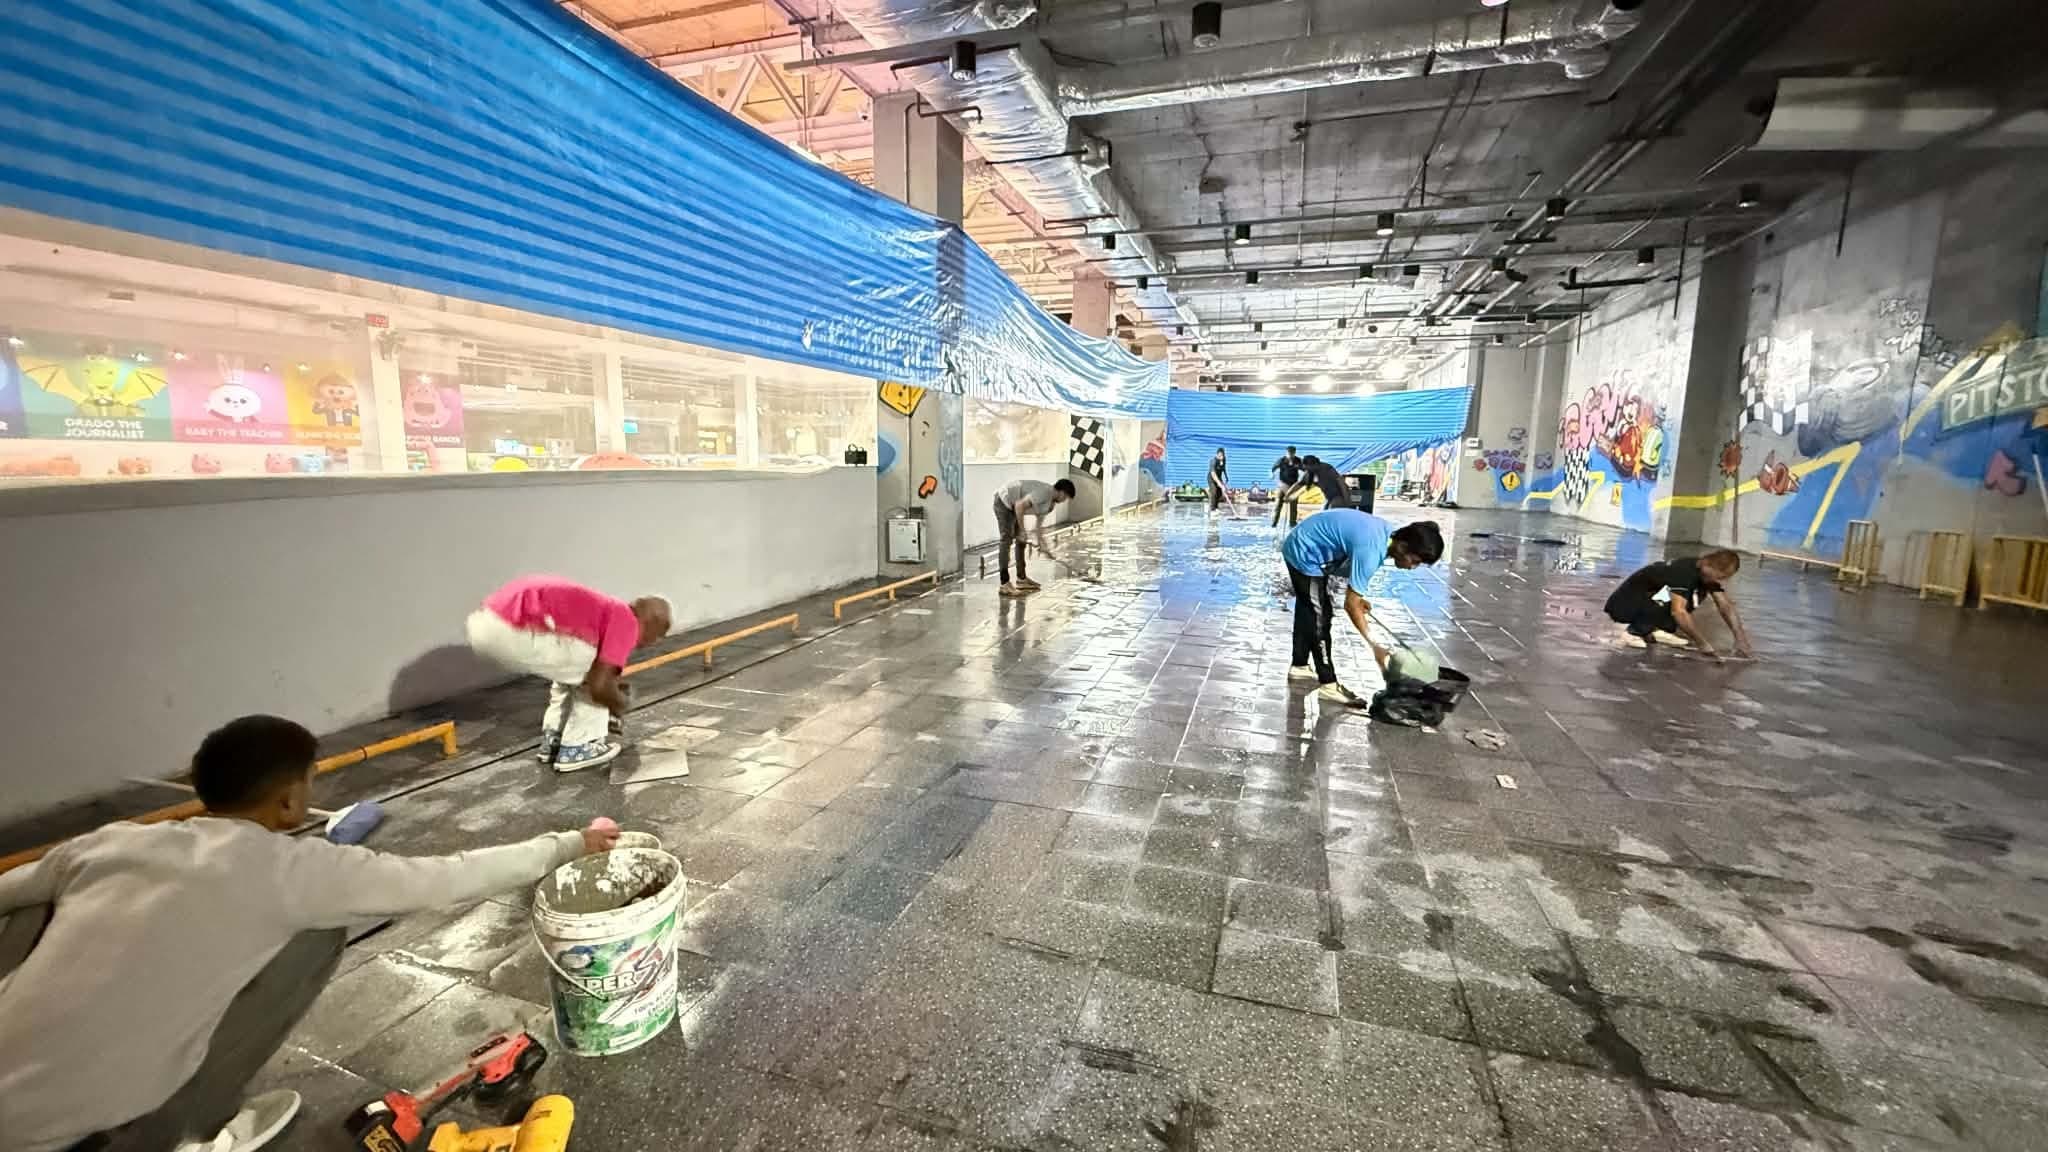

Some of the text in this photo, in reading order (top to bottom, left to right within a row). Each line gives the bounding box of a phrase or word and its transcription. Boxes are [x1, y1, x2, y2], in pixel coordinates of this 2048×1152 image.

[64, 417, 144, 430] DRAGO THE
[64, 428, 145, 440] JOURNALIST
